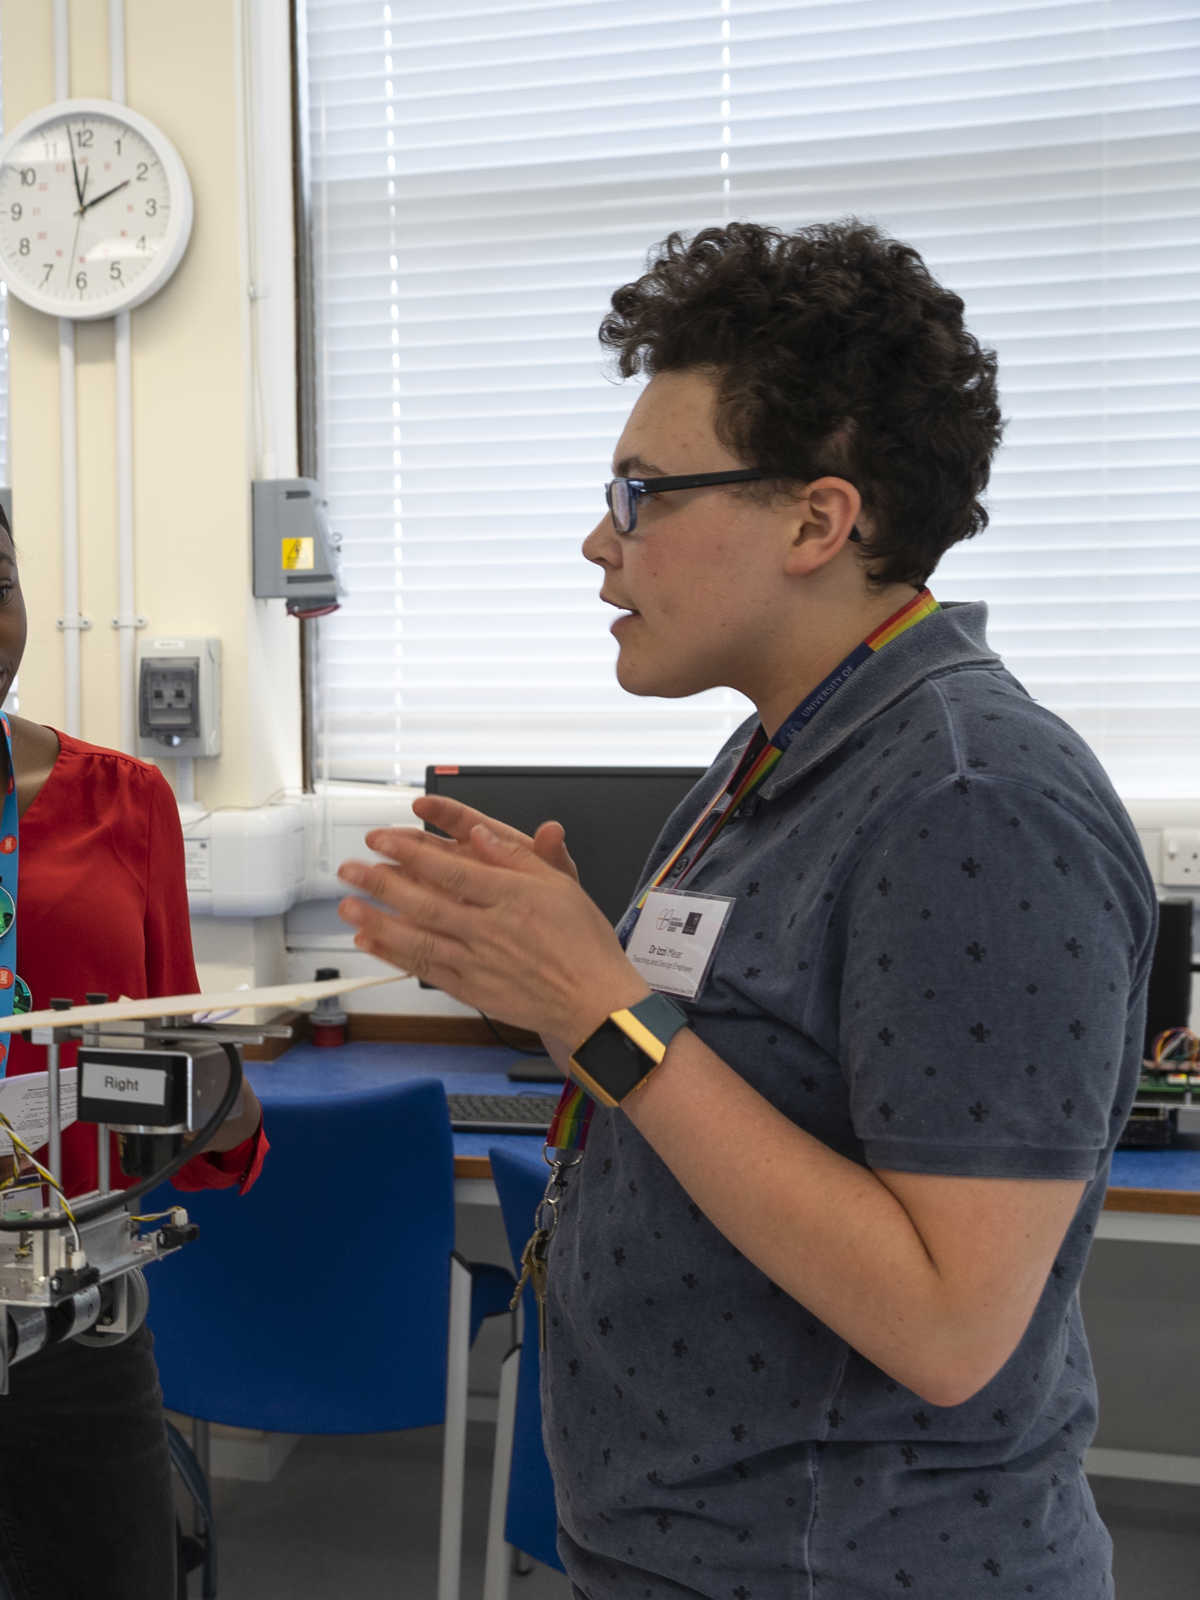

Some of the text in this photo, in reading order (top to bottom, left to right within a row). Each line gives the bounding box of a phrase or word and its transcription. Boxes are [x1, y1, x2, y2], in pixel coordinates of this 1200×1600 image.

[76, 129, 94, 148] 12
[114, 139, 121, 156] 1
[19, 167, 36, 187] 10
[136, 162, 148, 182] 2
[10, 202, 22, 221] 9
[145, 198, 157, 217] 3
[19, 238, 31, 257] 8
[135, 235, 146, 252] 4
[42, 263, 54, 281] 7
[109, 261, 122, 280] 5
[75, 272, 87, 290] 6
[104, 1075, 139, 1092] Right
